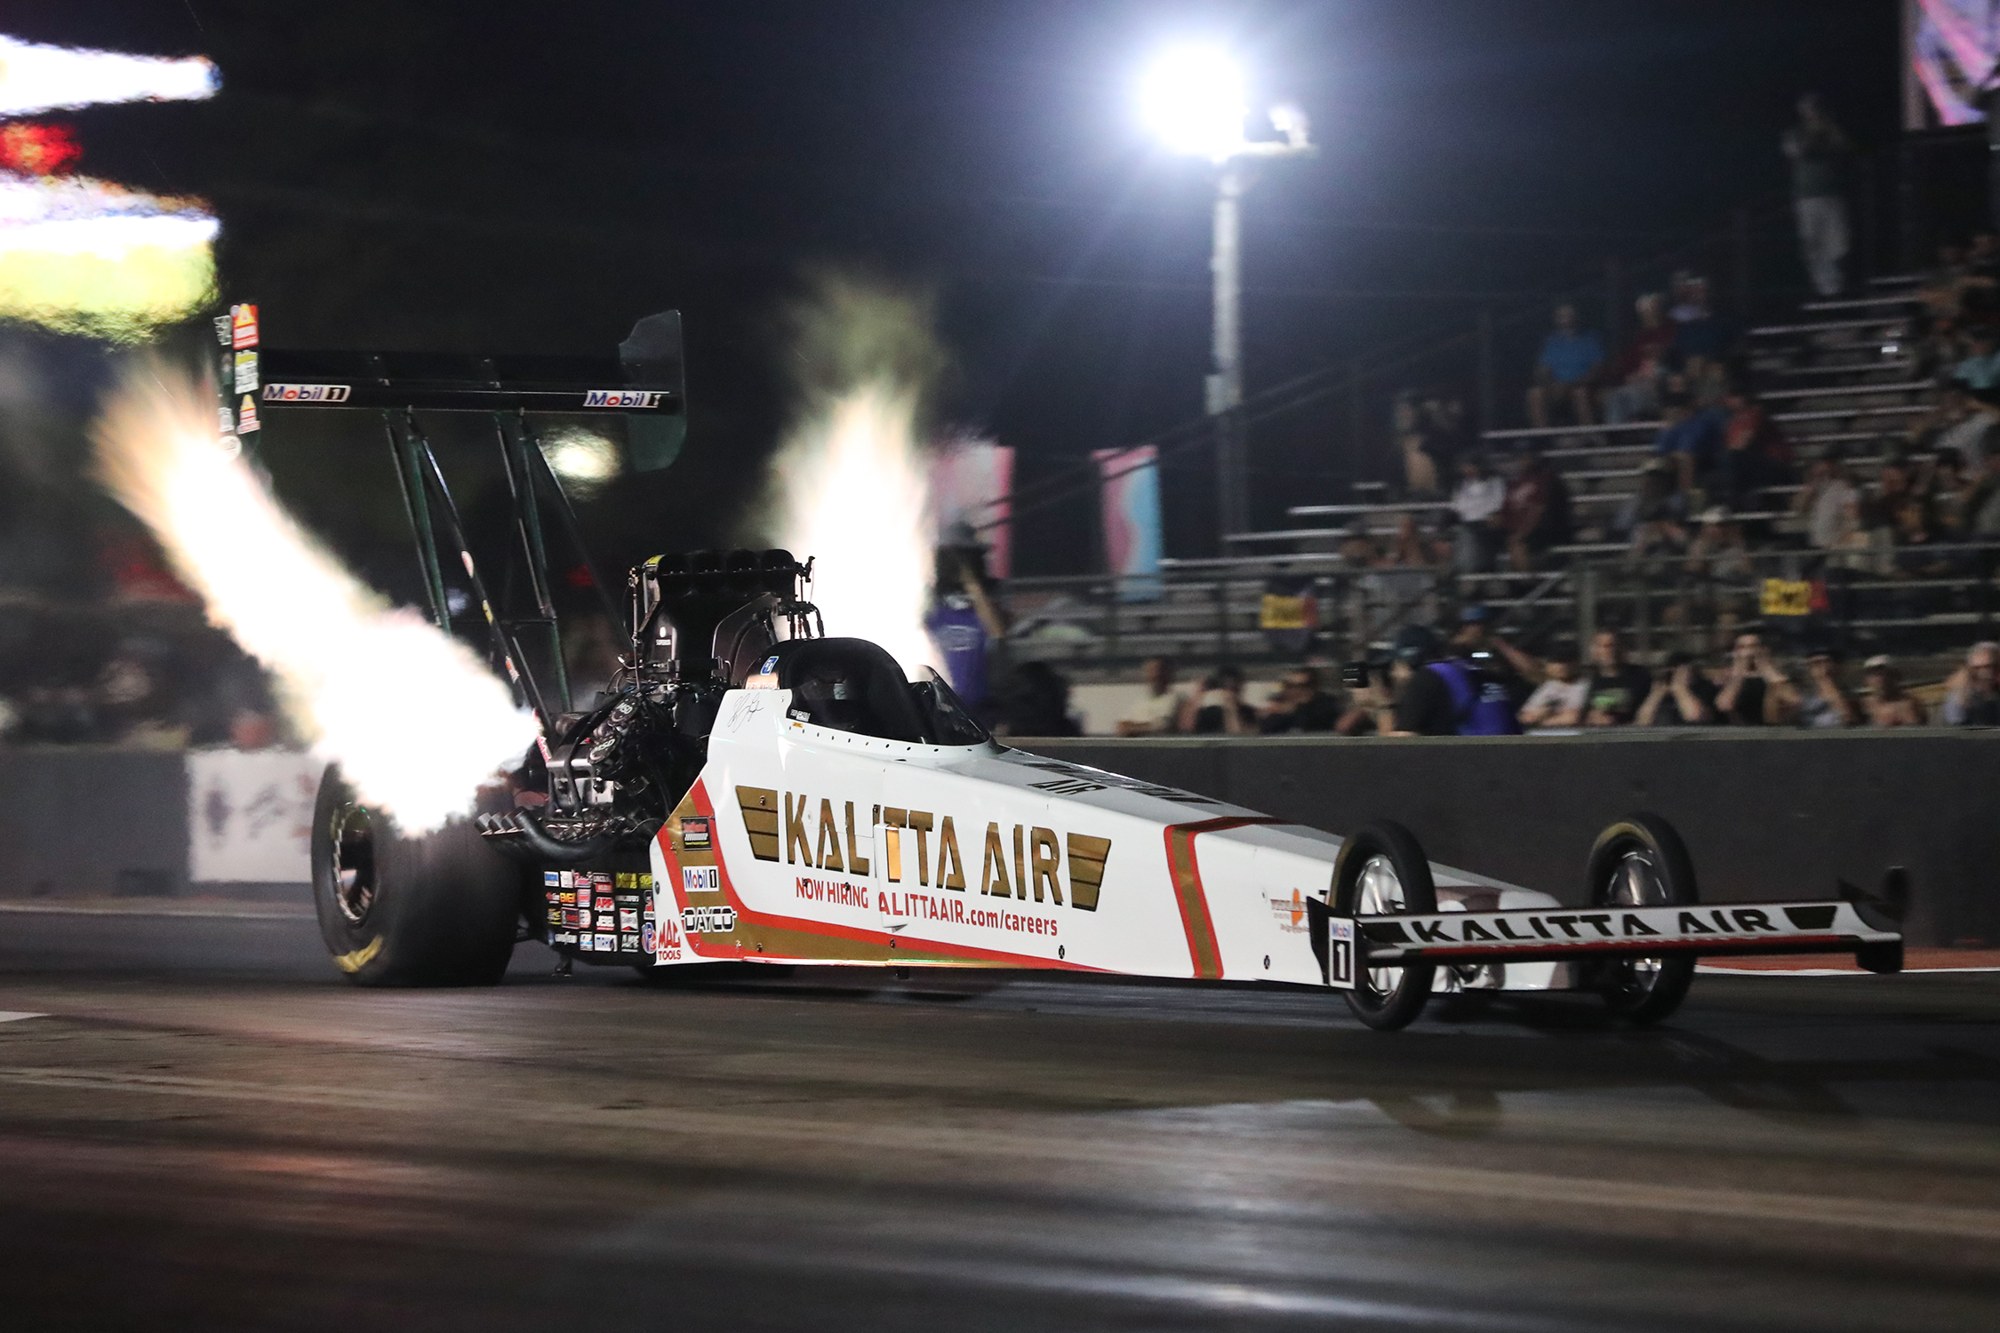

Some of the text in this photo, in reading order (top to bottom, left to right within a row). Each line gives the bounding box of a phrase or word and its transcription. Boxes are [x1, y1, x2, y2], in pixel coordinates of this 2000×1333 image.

[263, 386, 323, 400] Mobil
[587, 391, 645, 406] Mobil
[1027, 779, 1108, 796] AIR
[981, 821, 1064, 906] AIR
[684, 869, 708, 888] Mobil
[796, 876, 1058, 936] NOW HIRING ALITTAAIR.com/careers
[681, 907, 736, 932] DAYCO
[1411, 909, 1779, 943] KALITTA AIR
[658, 919, 682, 949] MAC
[658, 949, 682, 960] TOOLS
